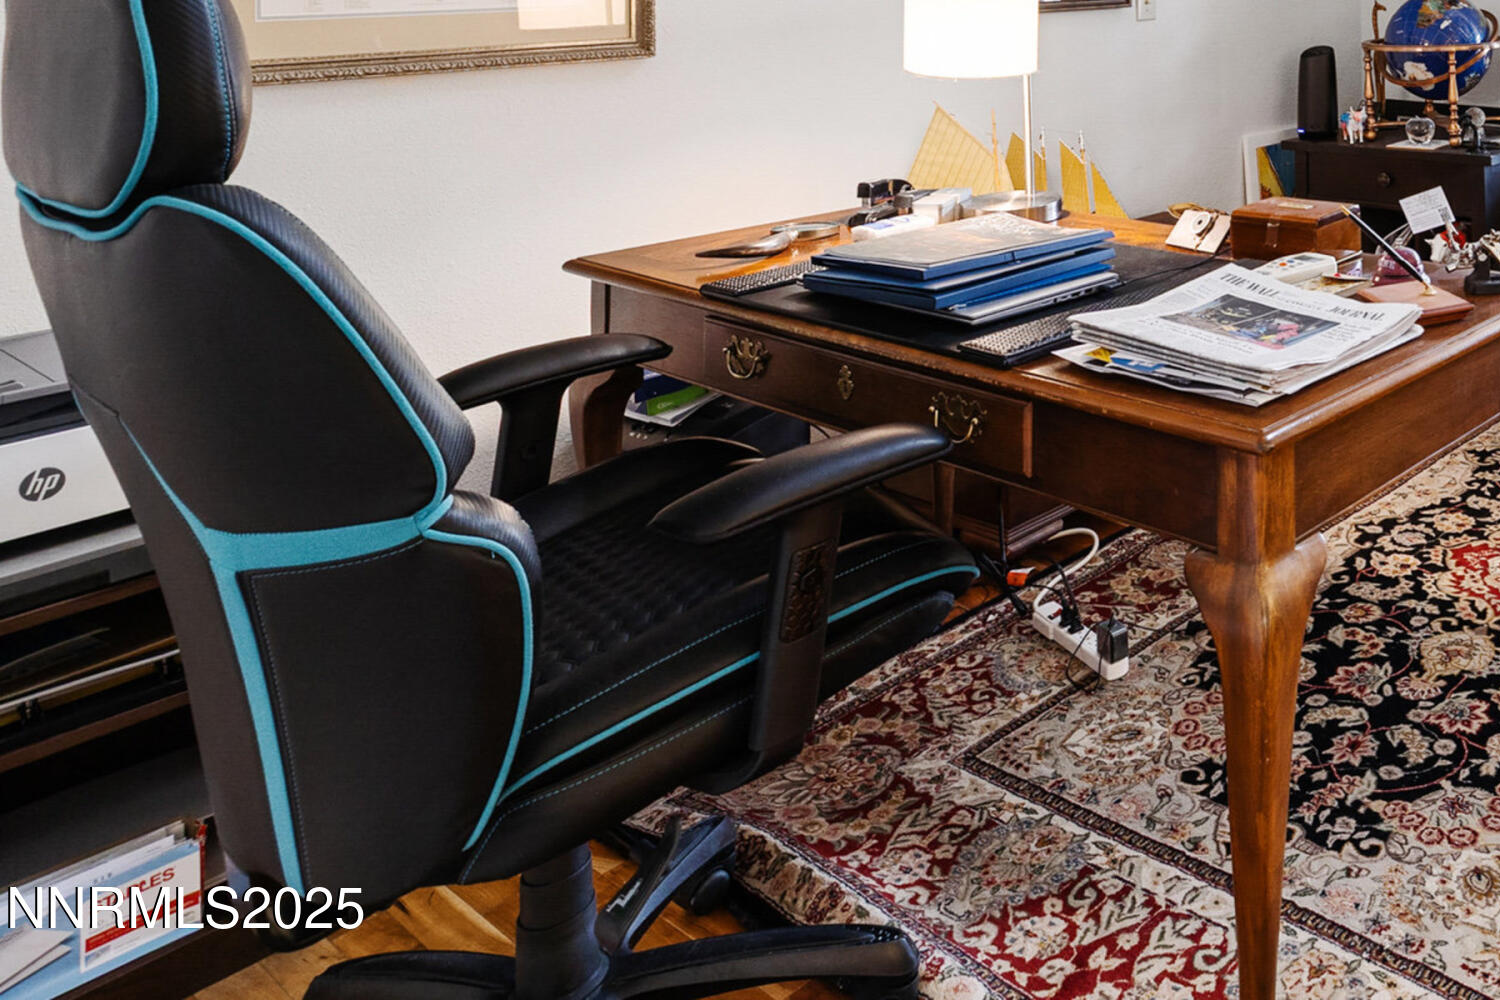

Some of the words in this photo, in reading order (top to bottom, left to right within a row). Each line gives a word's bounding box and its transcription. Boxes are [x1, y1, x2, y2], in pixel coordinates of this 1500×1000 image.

[1219, 273, 1250, 287] THE
[1247, 282, 1281, 298] WALL
[22, 468, 63, 502] hp
[96, 867, 175, 911] TLES
